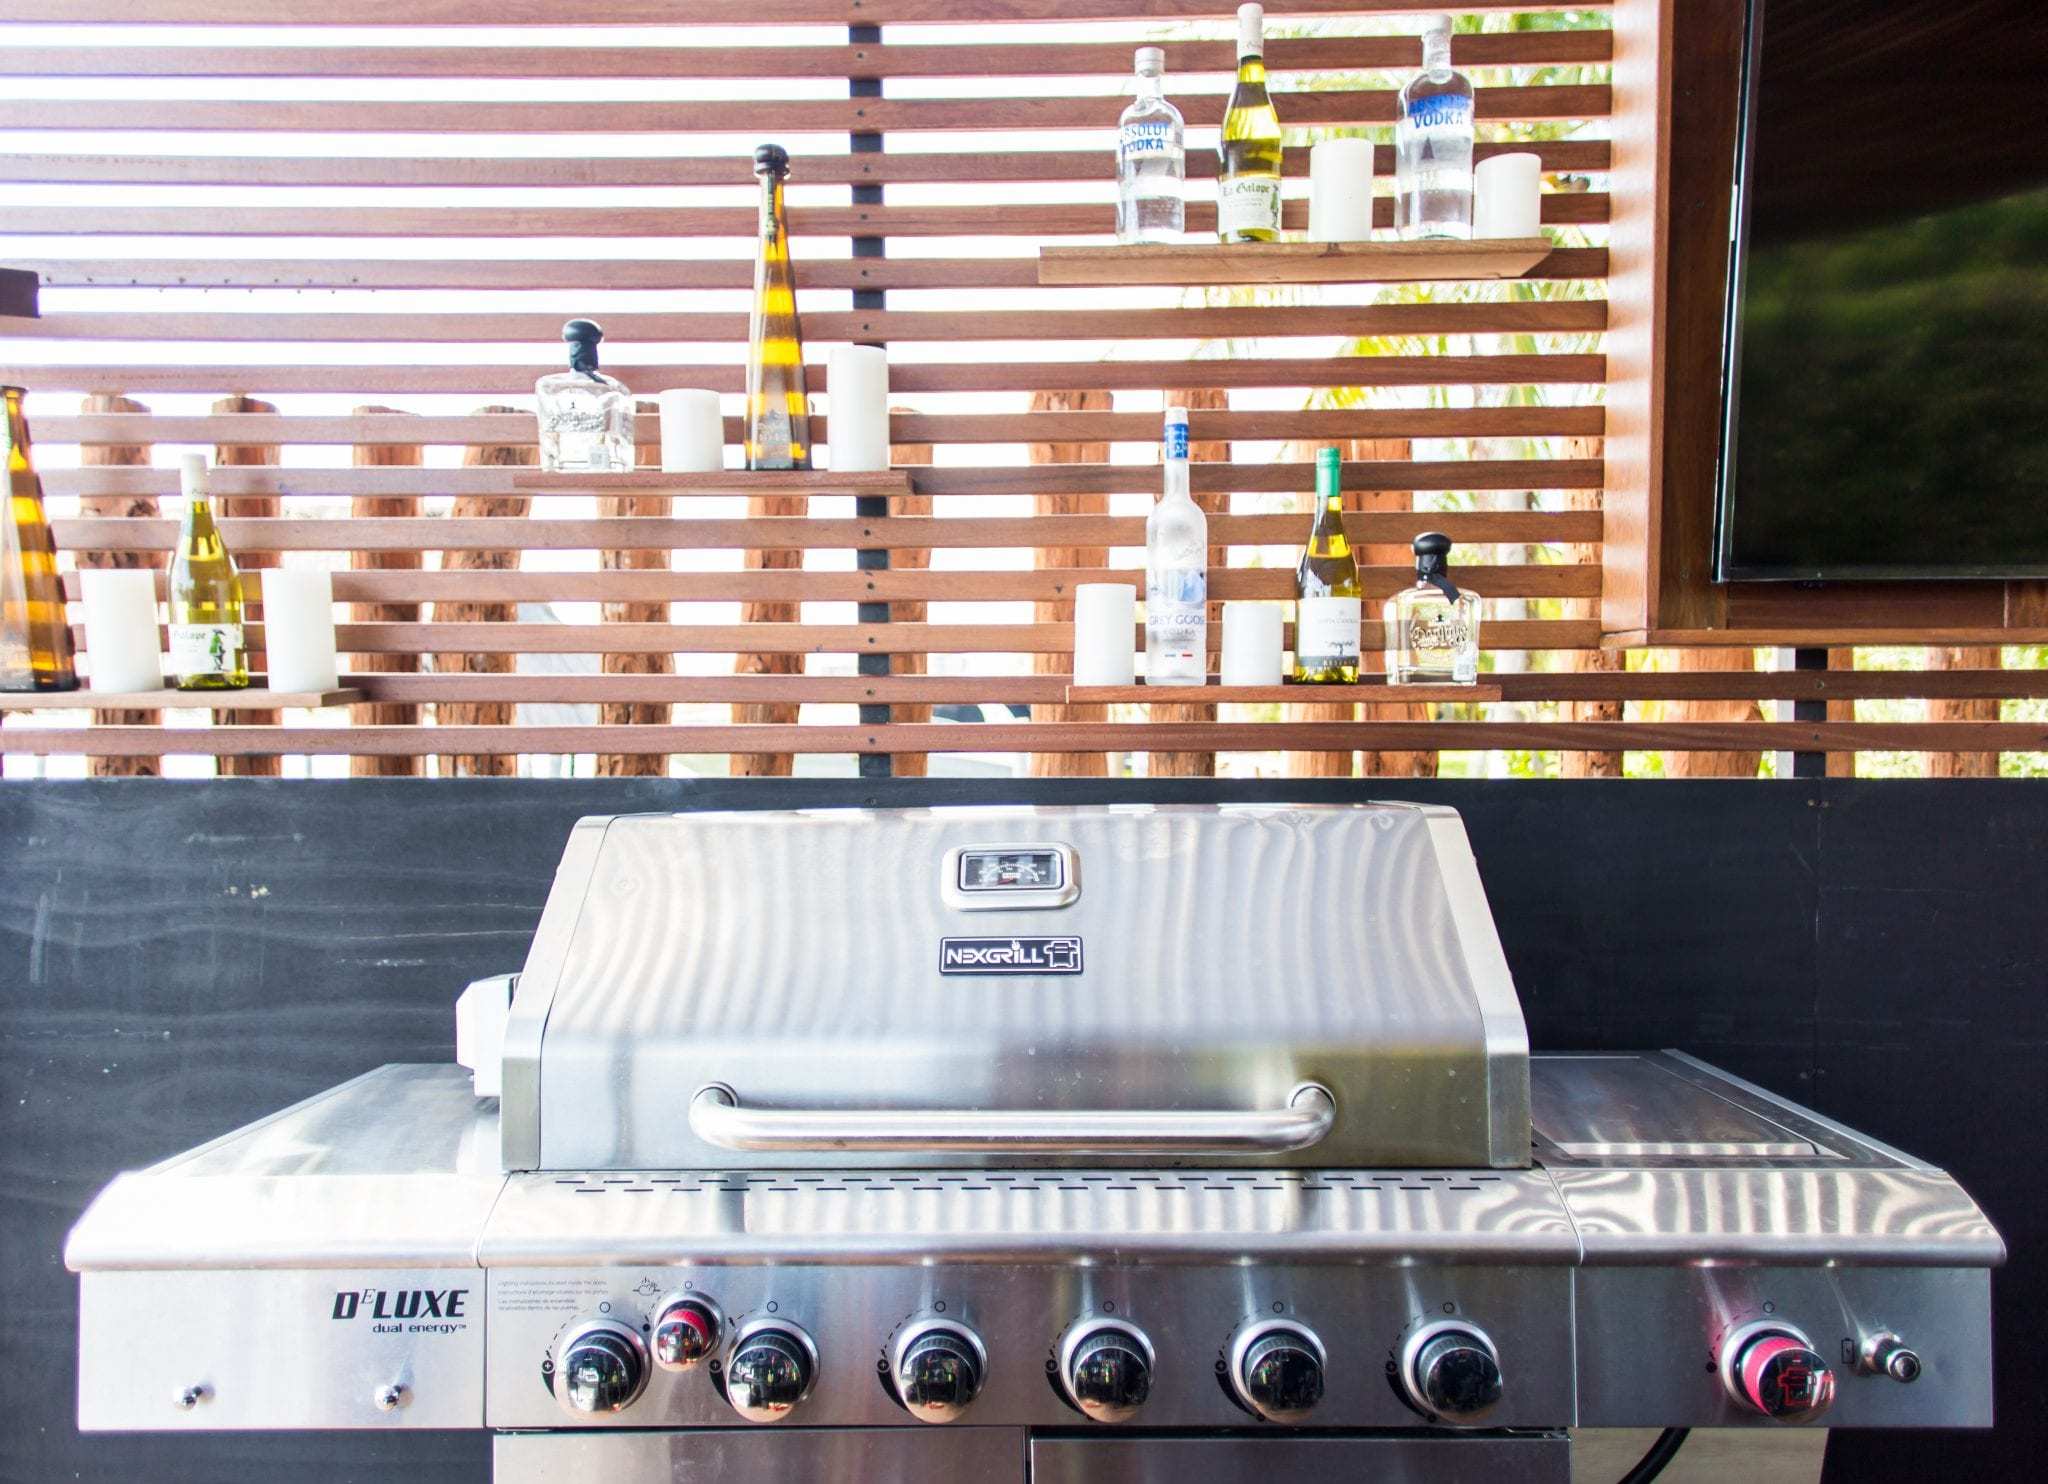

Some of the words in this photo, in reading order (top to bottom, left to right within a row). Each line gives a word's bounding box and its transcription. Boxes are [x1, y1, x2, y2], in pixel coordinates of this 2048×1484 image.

[1413, 109, 1464, 129] VODKA
[1121, 122, 1169, 138] BSOLUT
[1120, 138, 1165, 153] ODKA
[946, 941, 1044, 965] NEXGRILL
[372, 1323, 403, 1333] dual
